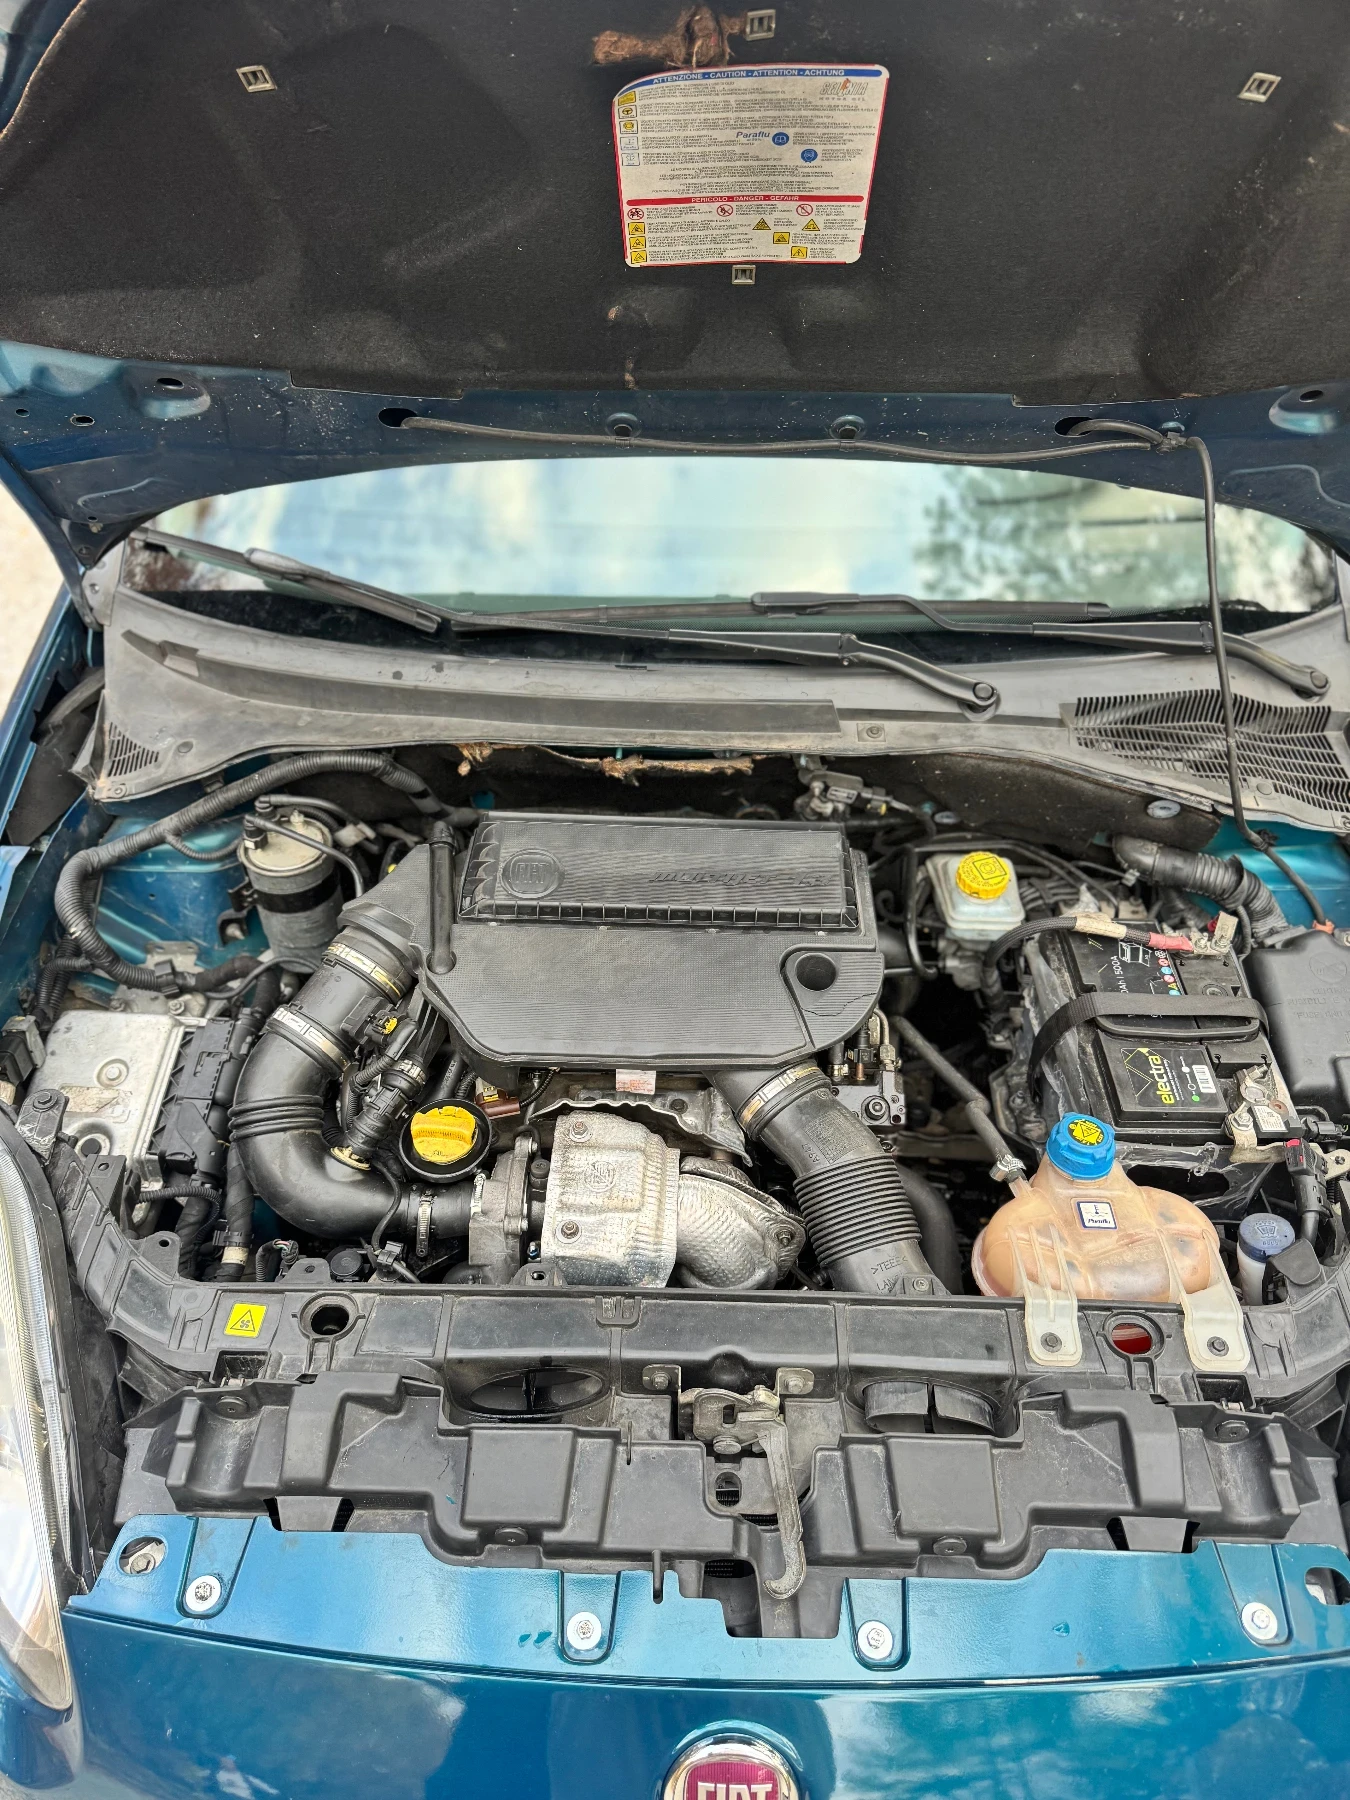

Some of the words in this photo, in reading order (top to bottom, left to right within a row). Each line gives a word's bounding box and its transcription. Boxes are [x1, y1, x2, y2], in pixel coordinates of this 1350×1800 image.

[652, 72, 703, 84] ATTENZIONE
[709, 70, 747, 79] CAUTION
[752, 69, 798, 77] ATTENTION
[736, 131, 770, 139] Paraflu
[516, 862, 550, 884] FIAT
[1110, 955, 1123, 975] 500A
[1148, 1055, 1175, 1104] electra
[697, 1781, 774, 1800] FIAT
